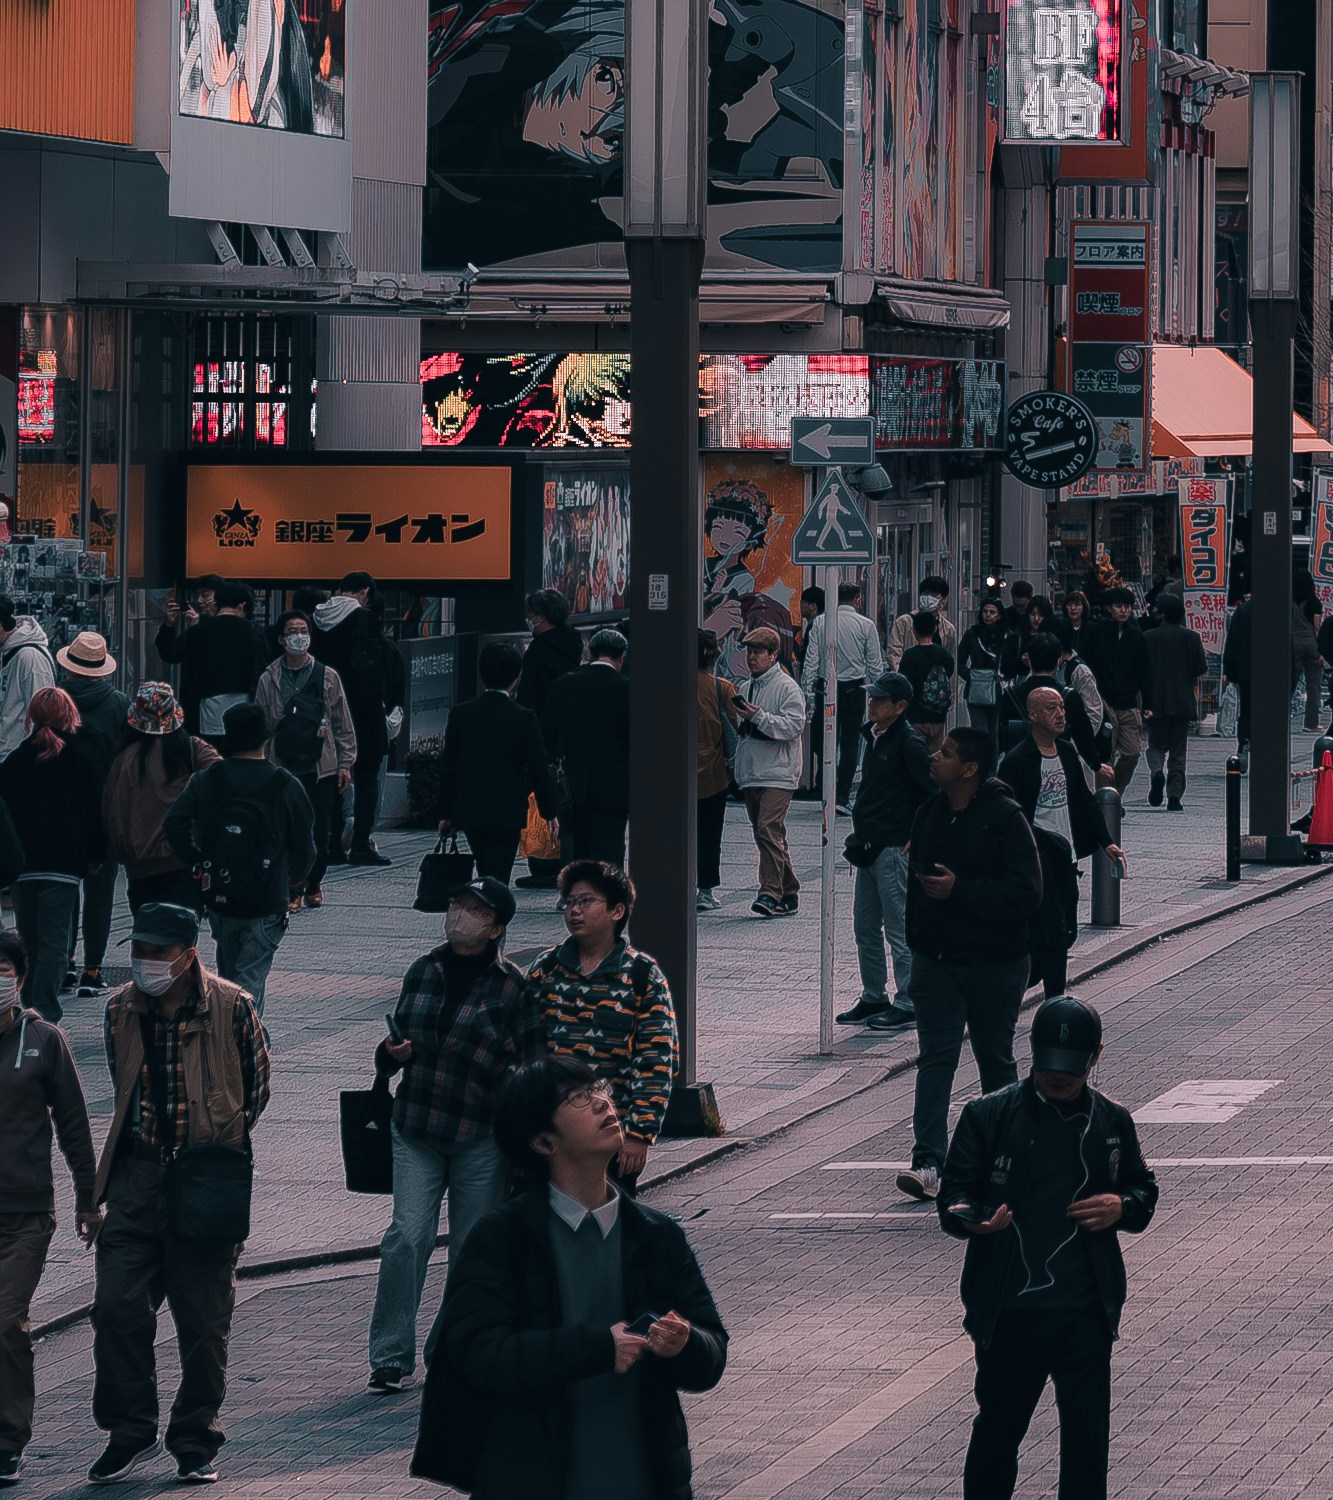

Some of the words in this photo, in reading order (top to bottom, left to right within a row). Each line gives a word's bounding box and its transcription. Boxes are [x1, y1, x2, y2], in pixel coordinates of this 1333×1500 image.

[1075, 243, 1145, 261] フロア案内
[275, 513, 487, 545] 銀座ライオン
[218, 539, 255, 547] LION
[1190, 507, 1218, 586] ダイコク
